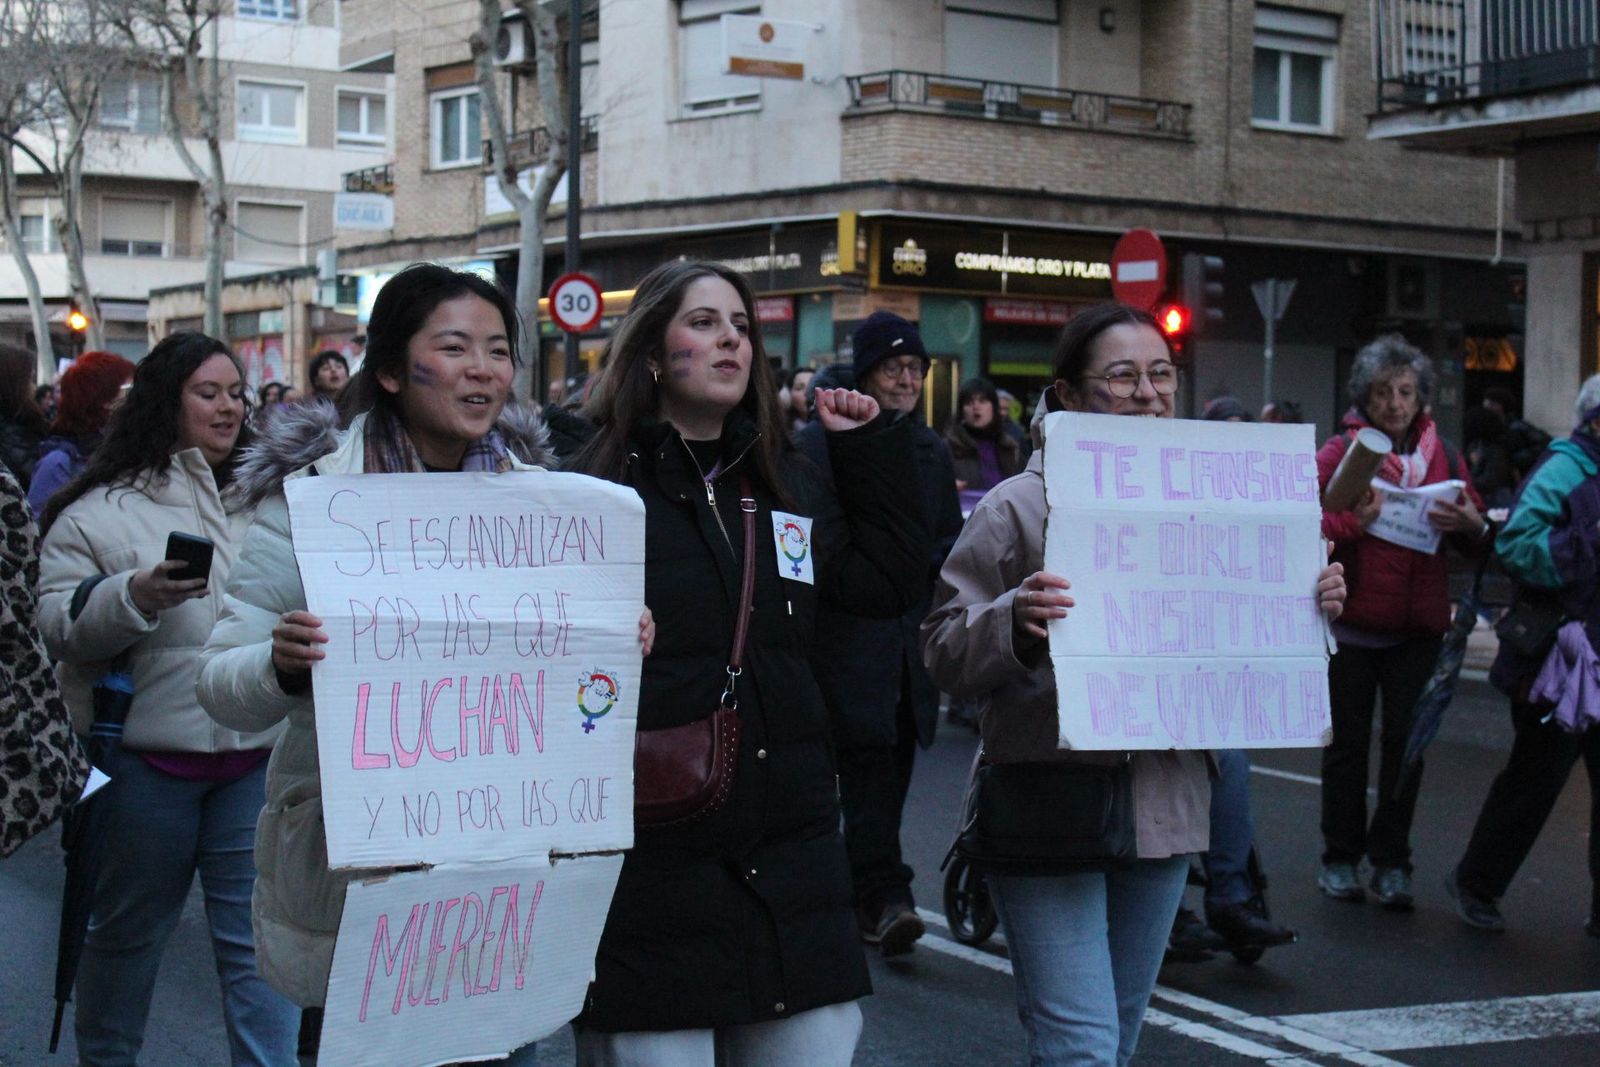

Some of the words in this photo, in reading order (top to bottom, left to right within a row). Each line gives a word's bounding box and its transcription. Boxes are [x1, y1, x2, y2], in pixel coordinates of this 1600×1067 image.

[955, 252, 1036, 275] COMPRAMOS
[1036, 258, 1063, 277] ORO
[1063, 260, 1073, 277] Y
[1073, 261, 1112, 280] PLATA
[562, 294, 591, 312] 30
[1075, 440, 1144, 499] TE
[1160, 447, 1316, 502] CANSAS
[410, 514, 605, 571] ESCANDALIZAN
[1094, 522, 1138, 573] DE
[349, 596, 422, 664] POR
[442, 593, 491, 660] LAS
[514, 590, 574, 658] QUE
[352, 670, 545, 770] LUCHAN
[1086, 671, 1152, 737] DE
[364, 797, 384, 840] Y
[402, 791, 442, 838] NO
[457, 785, 505, 832] POR
[521, 779, 558, 826] LAS
[568, 777, 611, 824] QUE
[359, 880, 545, 1023] MUEREN
